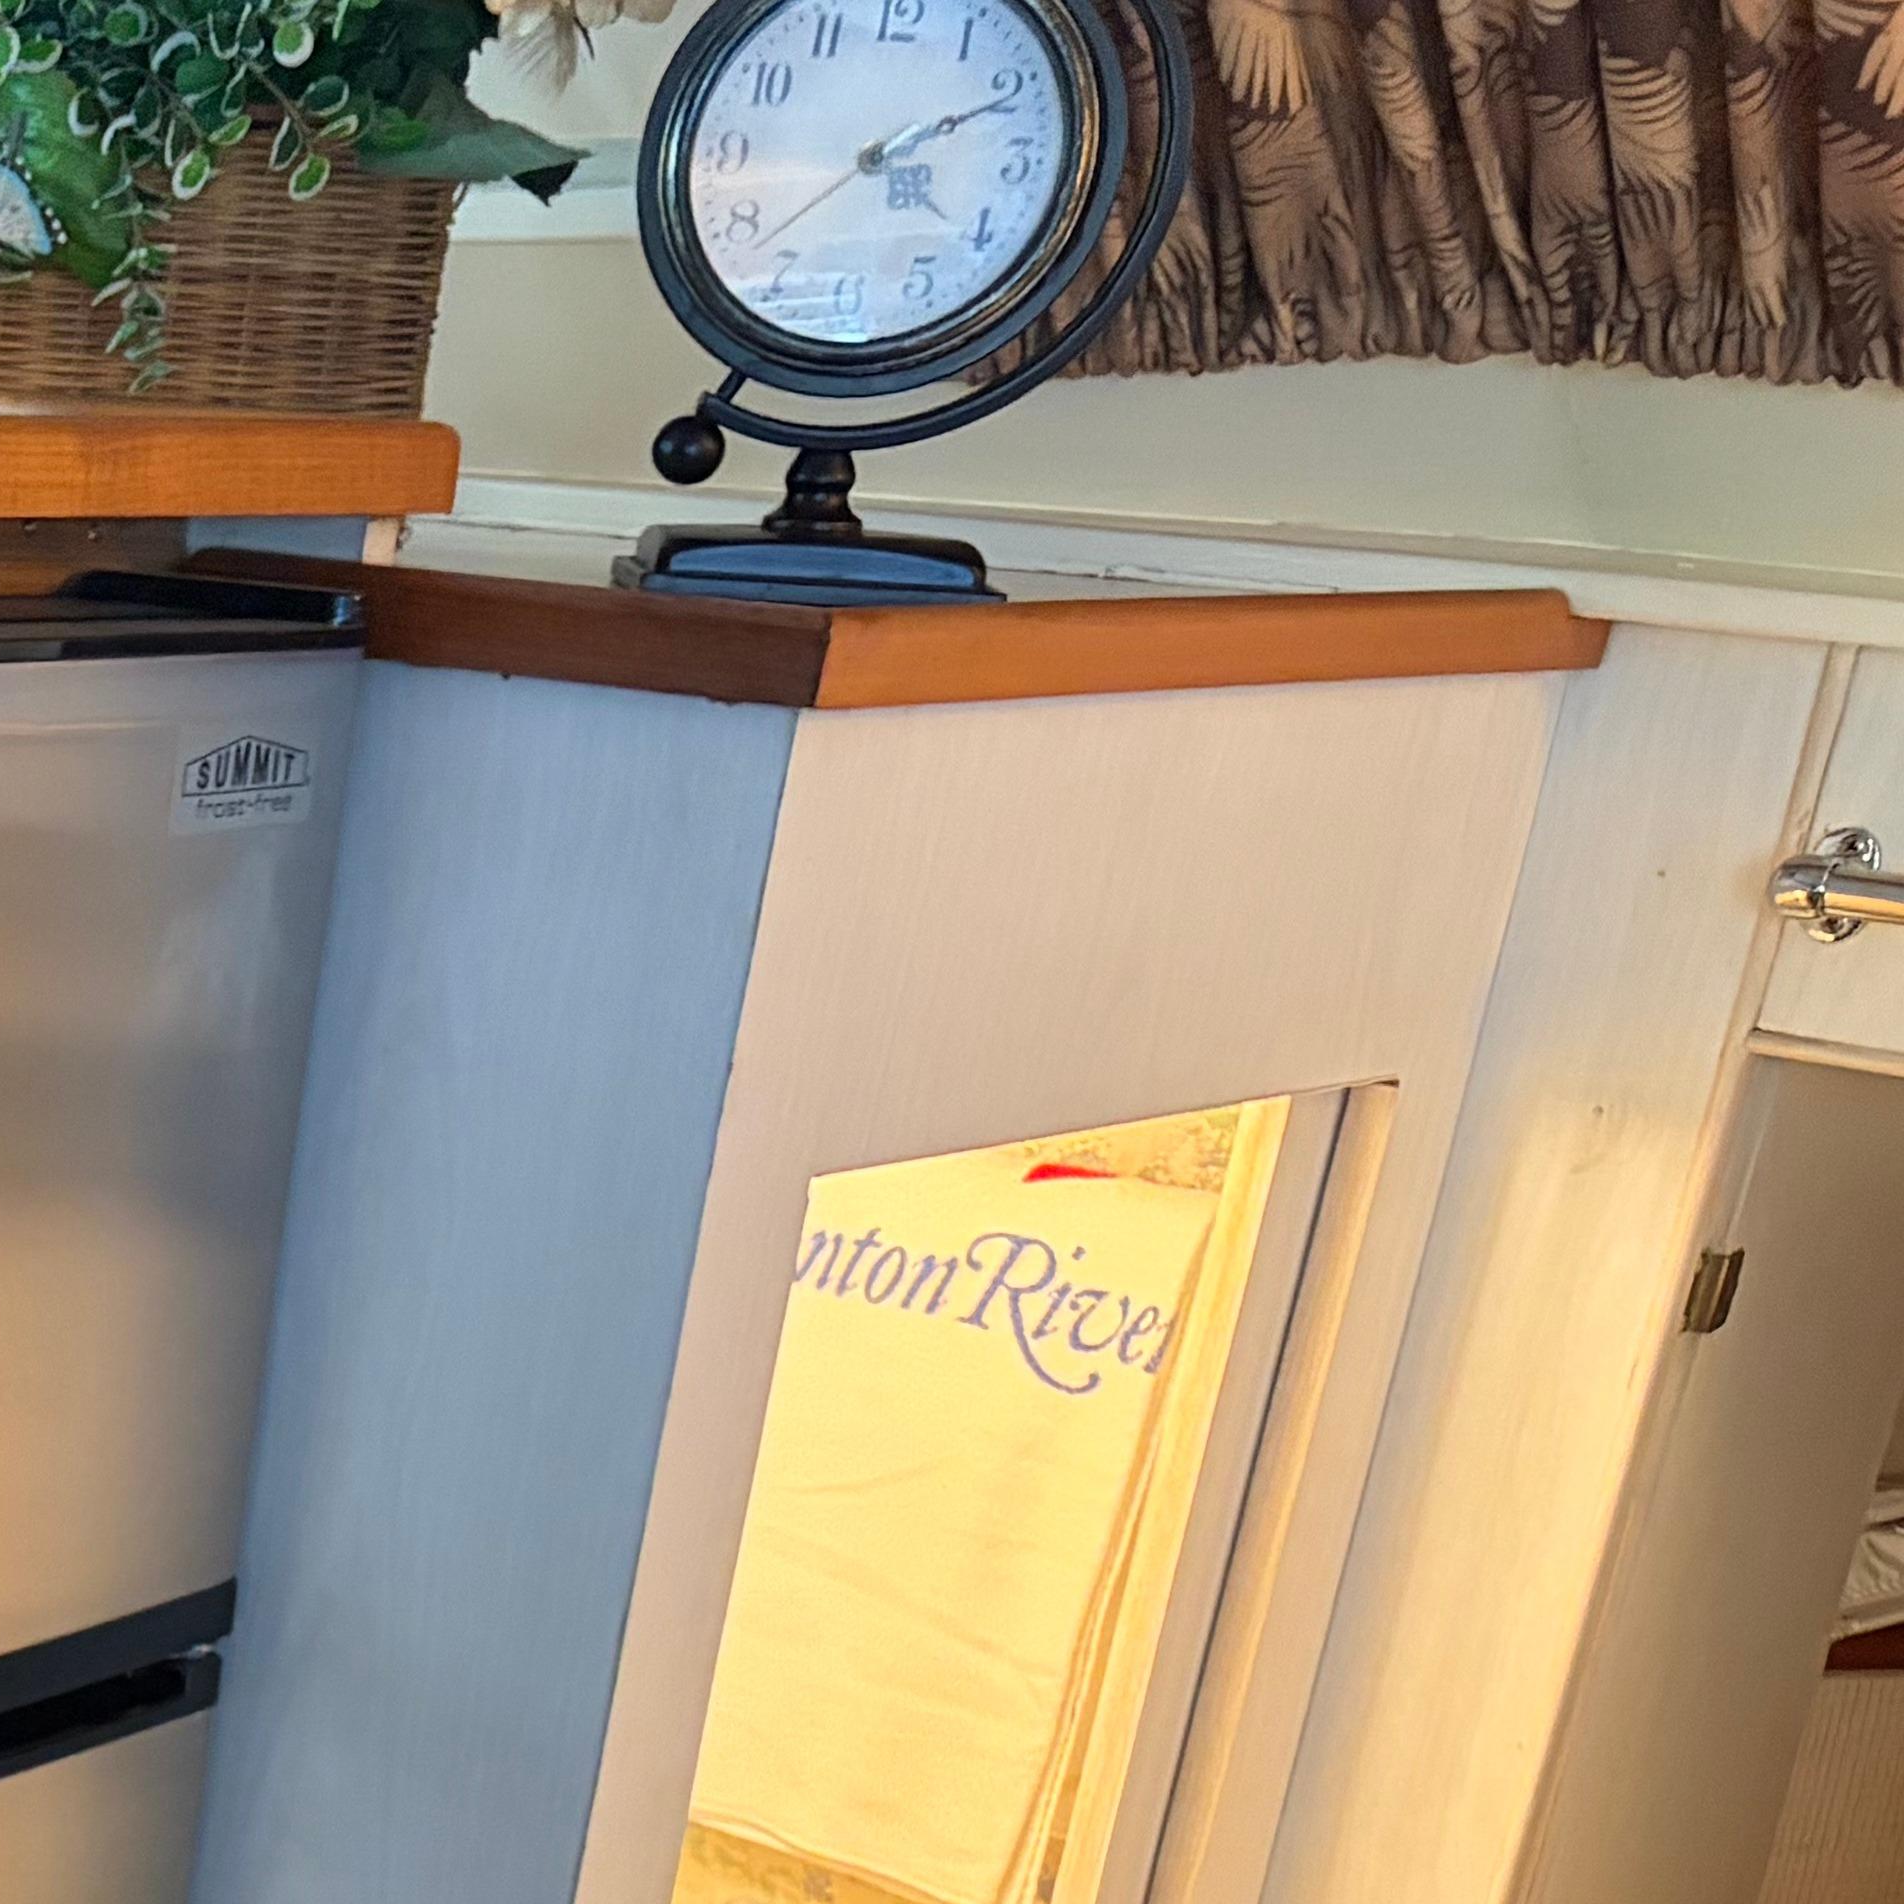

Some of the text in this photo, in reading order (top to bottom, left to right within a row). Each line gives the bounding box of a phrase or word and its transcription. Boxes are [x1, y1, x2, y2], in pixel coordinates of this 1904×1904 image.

[812, 13, 843, 58] 11
[877, 0, 924, 42] 12
[958, 17, 973, 61] 1
[753, 61, 792, 106] 10
[991, 68, 1023, 114] 2
[717, 129, 749, 174] 9
[1000, 137, 1034, 184] 3
[726, 199, 760, 243] 8
[961, 206, 993, 252] 4
[775, 250, 800, 293] 7
[833, 272, 866, 315] 6
[903, 255, 936, 298] 5
[196, 741, 295, 789] SUMMIT
